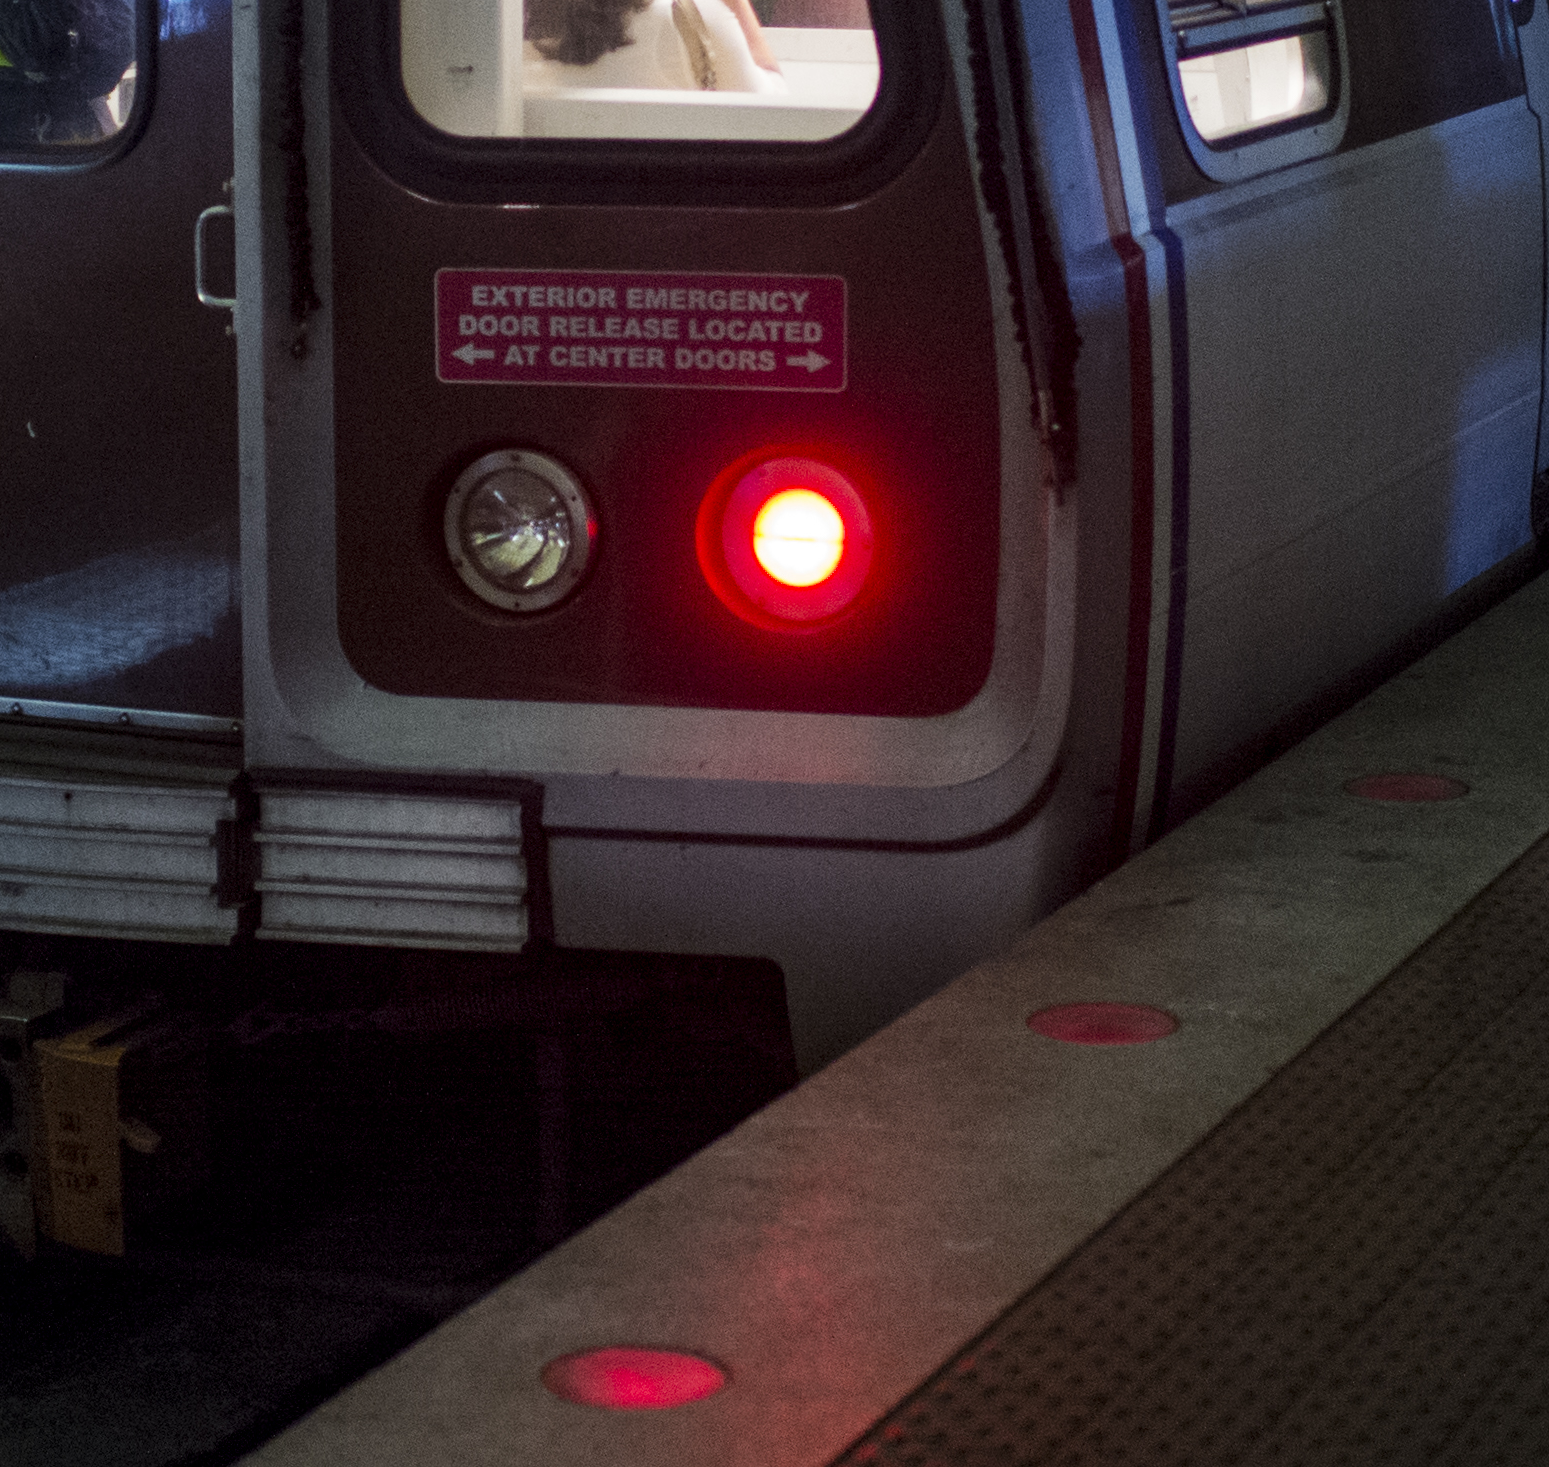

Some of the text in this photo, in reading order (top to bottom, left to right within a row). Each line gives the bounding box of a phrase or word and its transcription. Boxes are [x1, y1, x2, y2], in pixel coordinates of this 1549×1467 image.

[471, 285, 811, 313] EXTERIOR EMERGENCY
[458, 314, 823, 344] DOOR RELEASE LOCATED
[503, 345, 777, 372] AT CENTER DOORS
